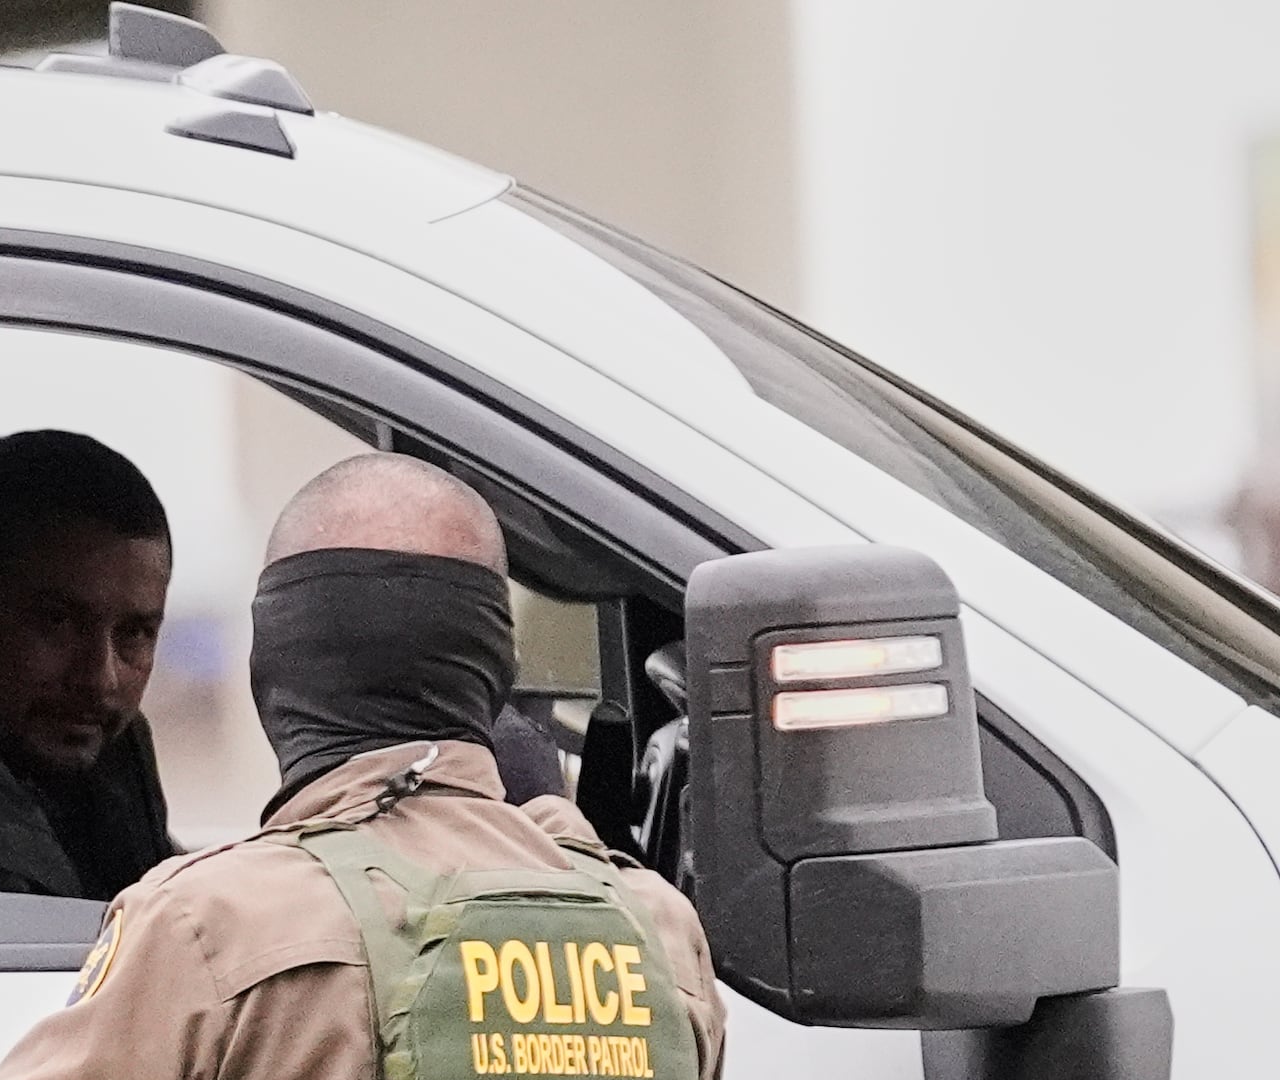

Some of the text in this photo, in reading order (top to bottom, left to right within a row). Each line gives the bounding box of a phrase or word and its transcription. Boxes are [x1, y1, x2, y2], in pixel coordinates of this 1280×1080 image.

[460, 939, 652, 1026] POLICE
[471, 1033, 654, 1078] U.S. BORDER PATROL
